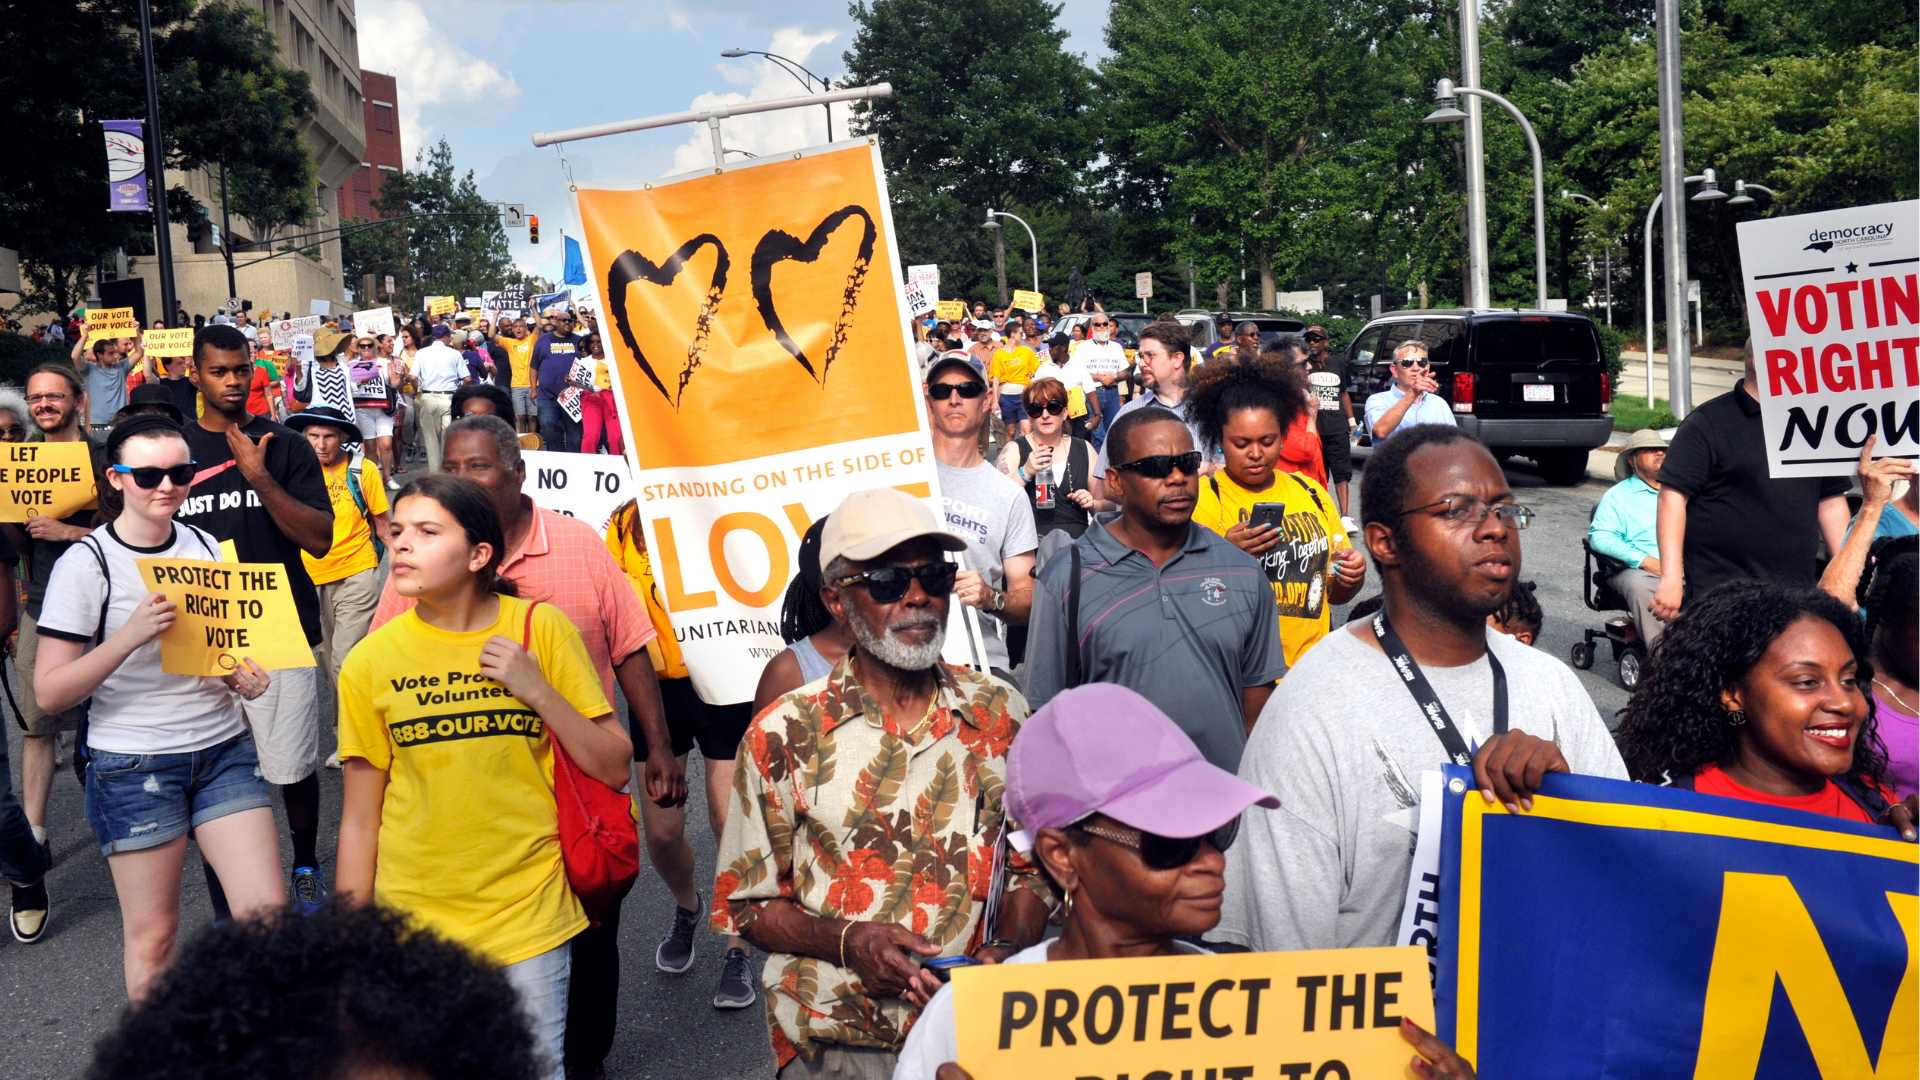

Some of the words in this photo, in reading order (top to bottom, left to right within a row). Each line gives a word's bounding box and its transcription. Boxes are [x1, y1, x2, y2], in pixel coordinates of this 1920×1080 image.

[1810, 223, 1893, 241] democracy
[1856, 234, 1887, 242] CAROLINA
[499, 291, 524, 300] LIVES
[91, 312, 108, 320] OUR
[112, 310, 130, 319] VOTE
[293, 318, 316, 328] STOP
[90, 323, 107, 331] OUR
[110, 321, 132, 329] VOICE
[168, 341, 192, 349] VOICE
[1311, 375, 1339, 384] DANGER
[10, 447, 38, 462] LET
[16, 468, 80, 483] PEOPLE
[538, 468, 567, 490] NO
[594, 471, 620, 494] TO
[643, 478, 745, 501] STANDING
[753, 470, 787, 490] ON
[793, 461, 836, 484] THE
[843, 452, 892, 474] SIDE
[899, 447, 925, 464] OF
[10, 490, 52, 505] VOTE
[178, 494, 214, 517] JUST
[220, 490, 242, 510] DO
[944, 511, 988, 535] IGHTS
[1256, 550, 1290, 580] rking
[1289, 533, 1328, 573] Together
[152, 566, 231, 590] PROTECT
[239, 572, 278, 590] THE
[185, 594, 229, 619] RIGHT
[238, 600, 262, 619] TO
[206, 626, 250, 648] VOTE
[672, 620, 780, 643] UNITARIAN
[390, 676, 440, 693] Vote
[416, 686, 514, 706] Voluntee
[392, 714, 542, 744] 888-OUR-VOTE
[998, 978, 1271, 1050] PROTECT
[1296, 972, 1405, 1032] THE
